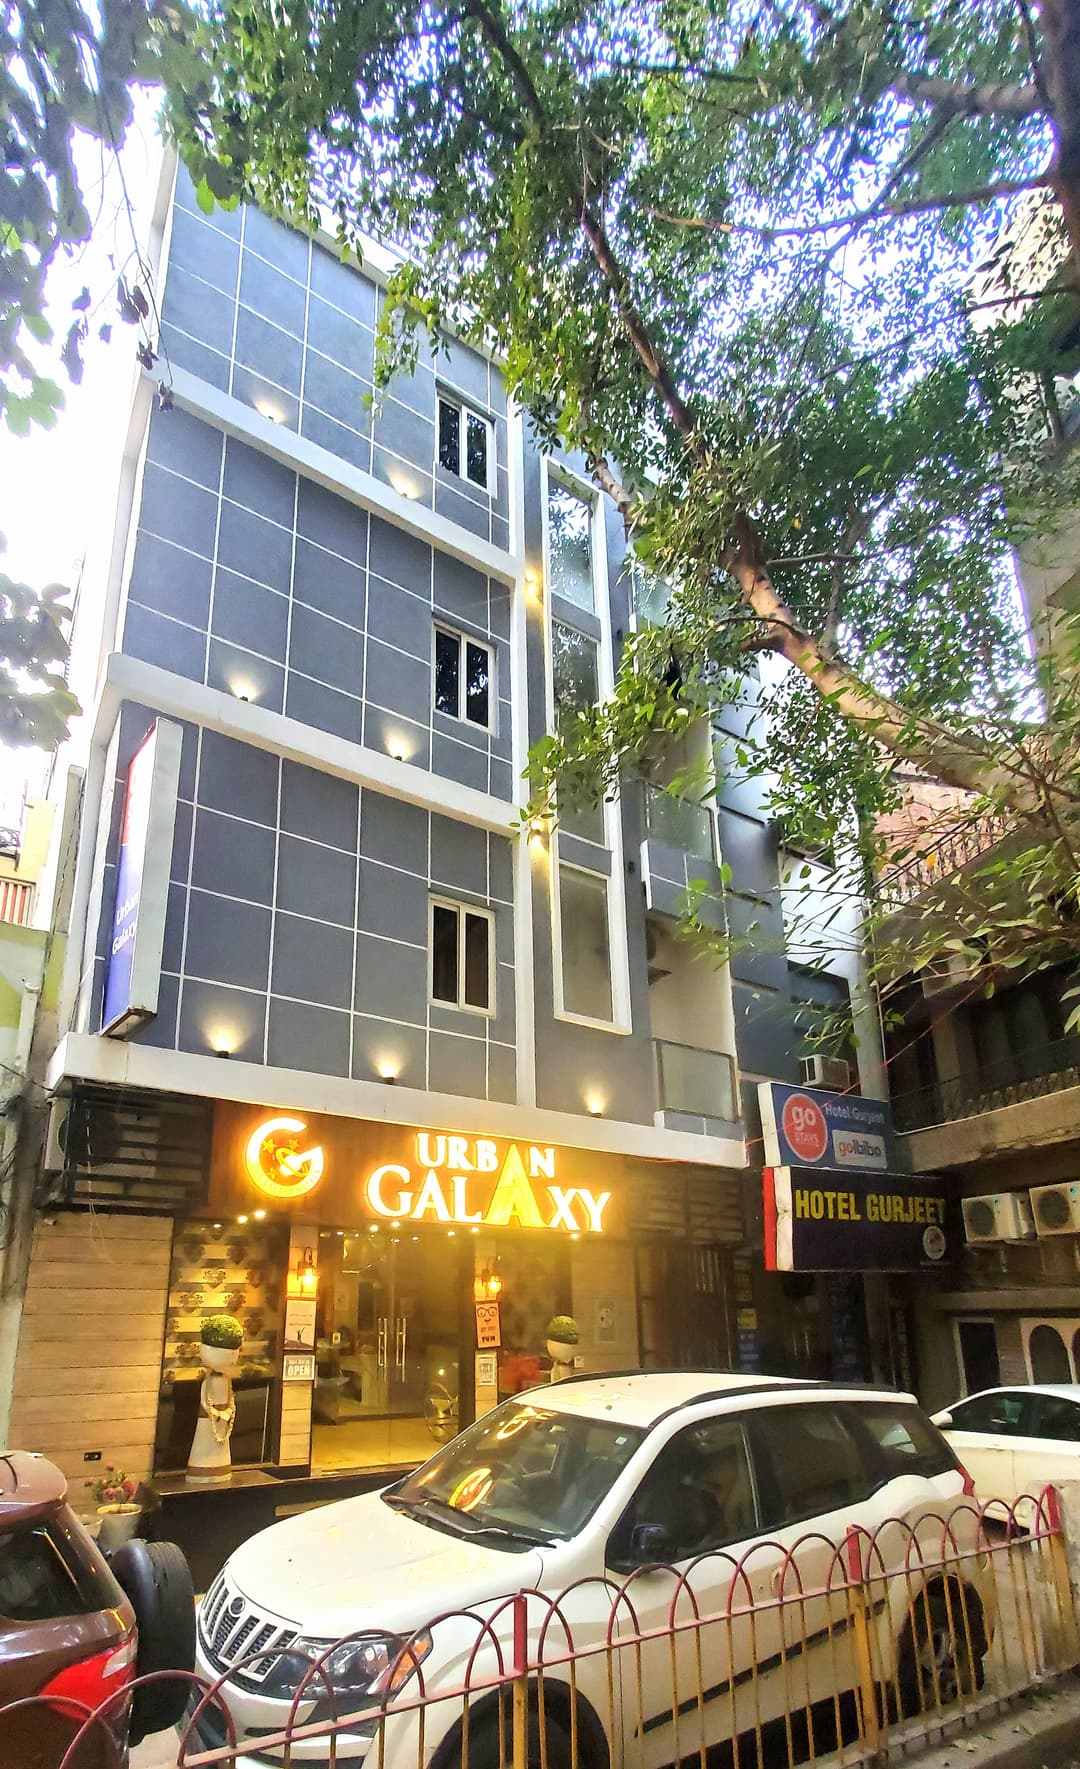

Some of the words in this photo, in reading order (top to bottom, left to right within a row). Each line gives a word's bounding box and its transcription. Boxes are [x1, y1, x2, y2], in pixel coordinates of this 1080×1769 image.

[112, 921, 137, 955] Galaxy
[792, 1106, 817, 1131] go
[825, 1103, 852, 1119] Hotel
[417, 1132, 556, 1180] URBAN
[838, 1139, 882, 1157] goibibo
[366, 1144, 612, 1232] GALAXY
[795, 1189, 861, 1221] HOTEL
[865, 1194, 946, 1224] GURJEET
[287, 1365, 310, 1378] OPEN
